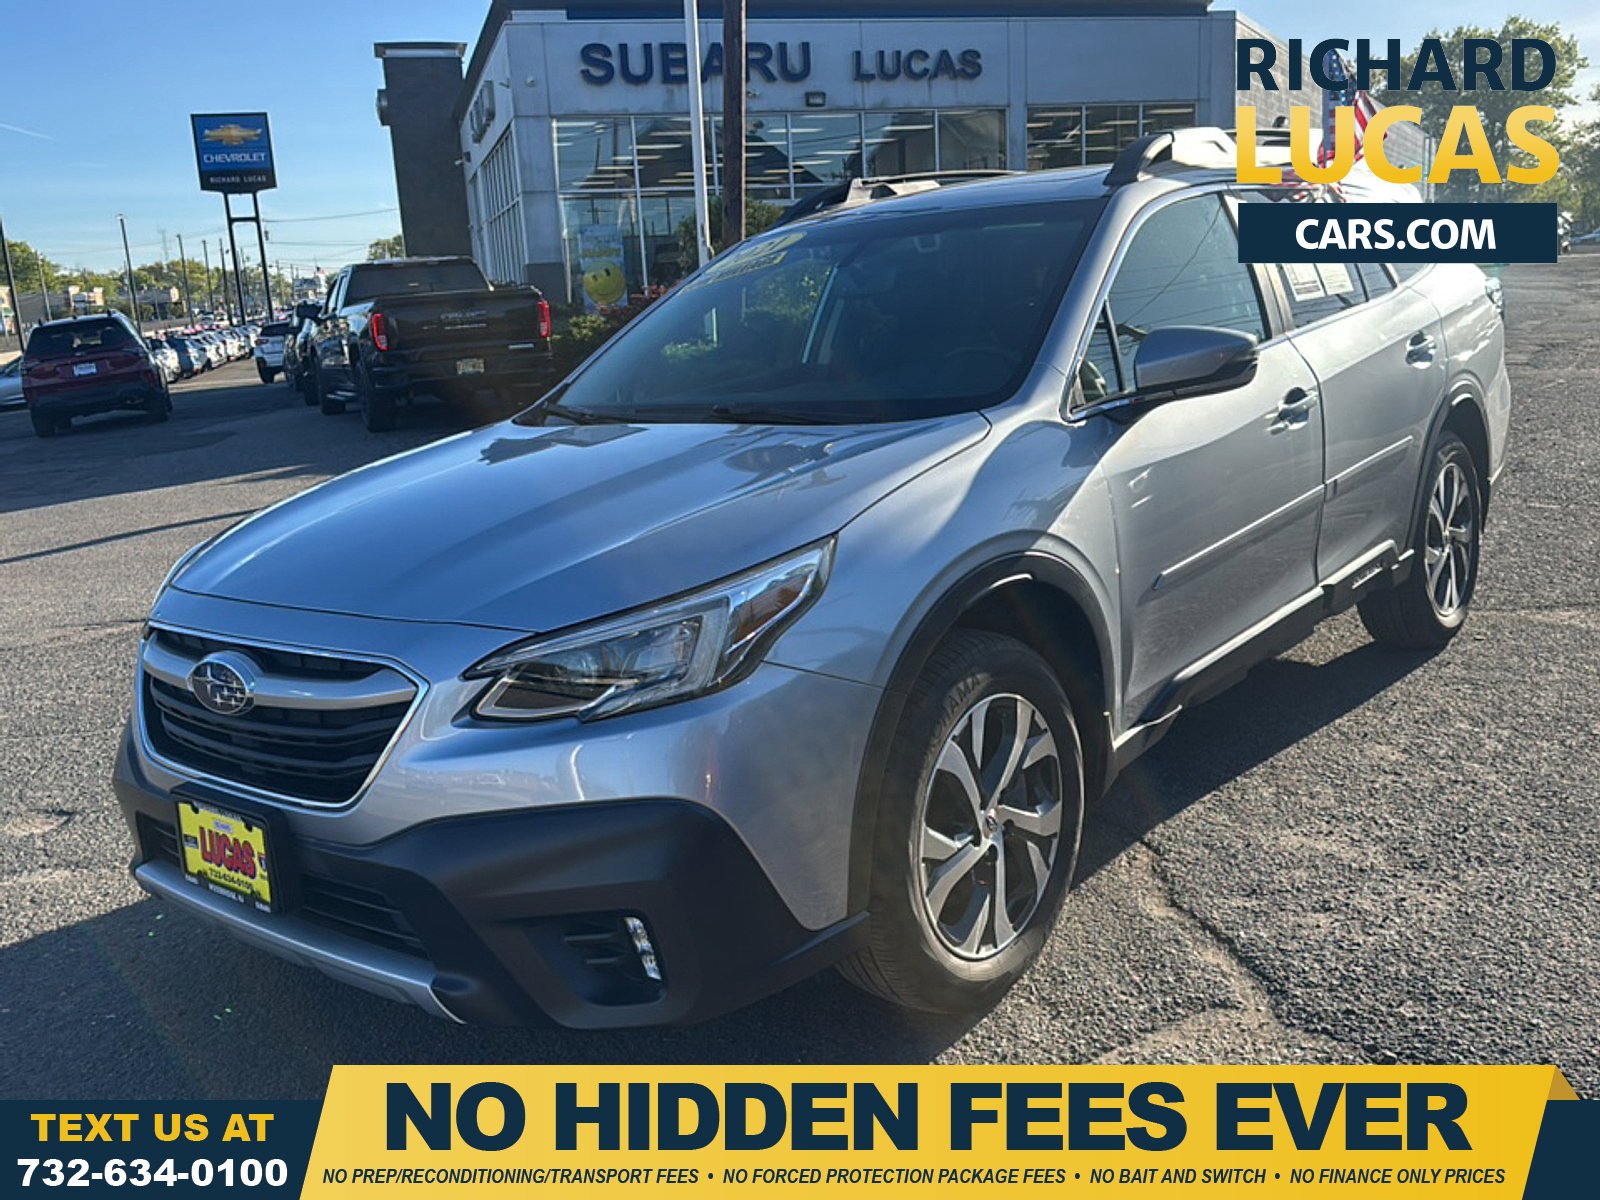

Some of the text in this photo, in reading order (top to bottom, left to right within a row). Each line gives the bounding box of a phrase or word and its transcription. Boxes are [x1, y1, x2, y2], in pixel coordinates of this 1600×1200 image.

[580, 41, 982, 86] SUBARU LUCAS
[203, 151, 266, 163] CHEVROLET
[198, 825, 258, 880] LUCAS
